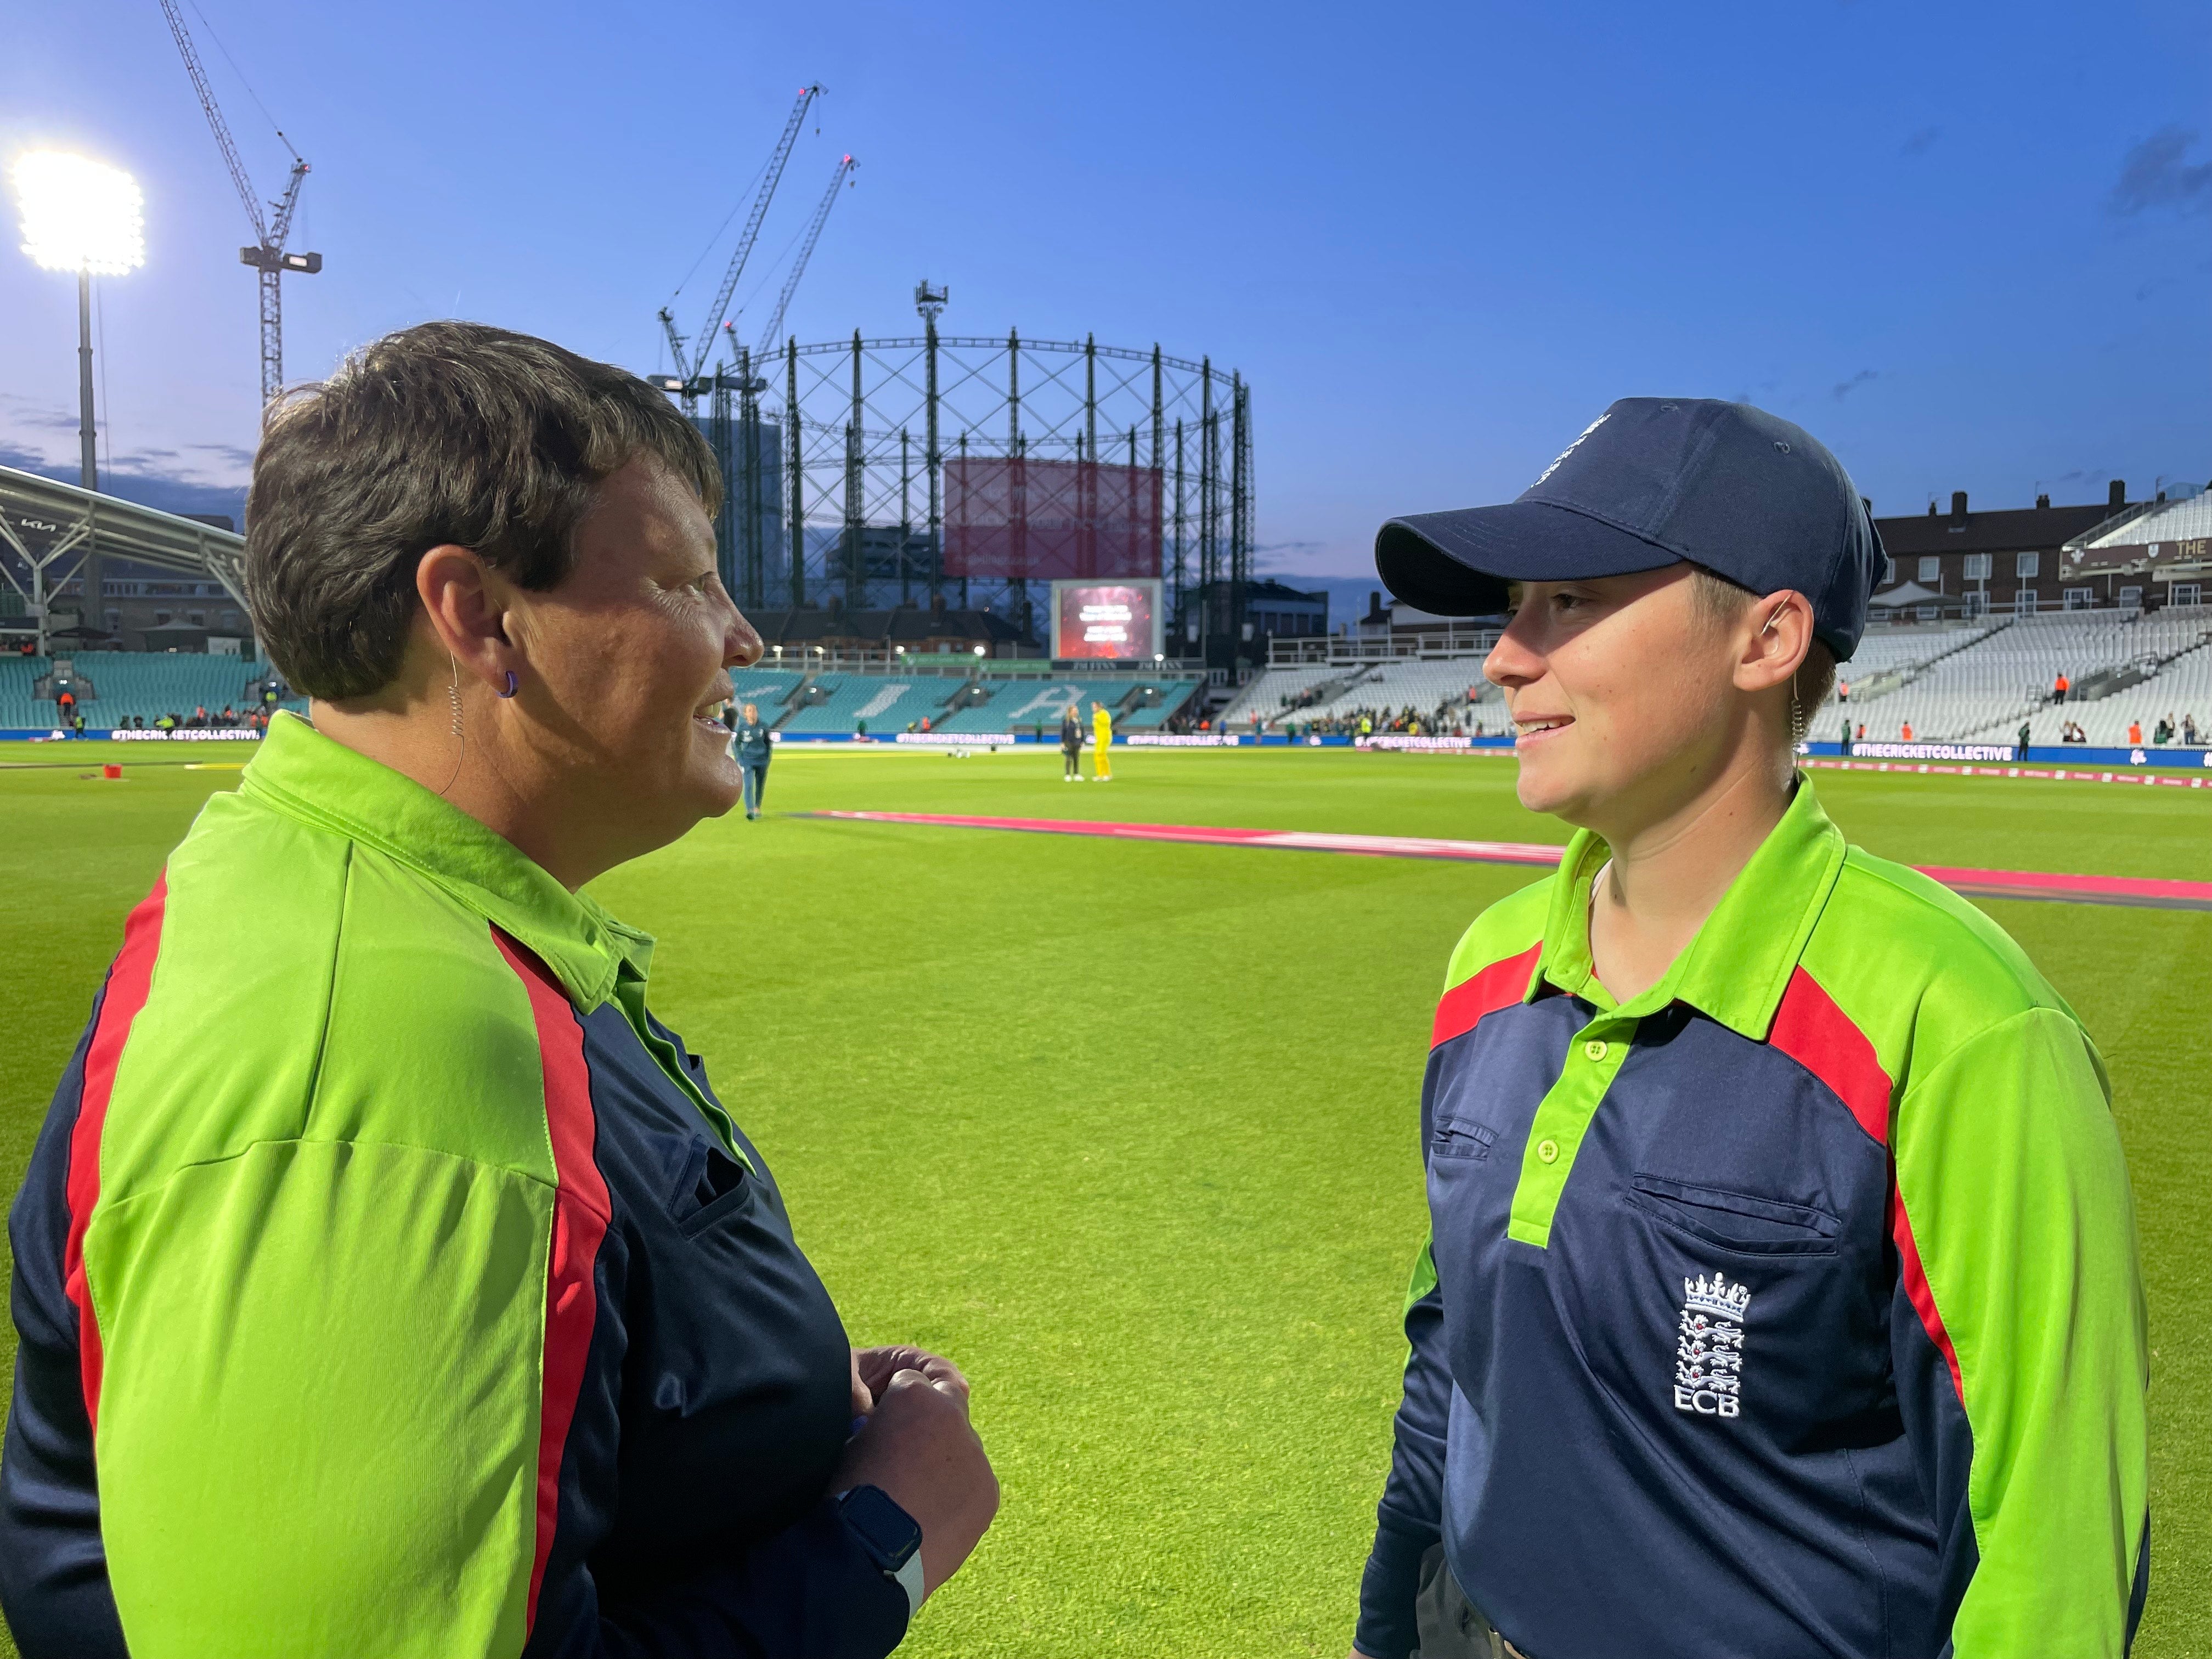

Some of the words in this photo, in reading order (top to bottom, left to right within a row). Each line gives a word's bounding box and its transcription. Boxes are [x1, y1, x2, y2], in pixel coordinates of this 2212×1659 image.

[2176, 539, 2207, 556] THE
[1852, 743, 2012, 761] #THECRICKETCOLLECTIVE
[1674, 1384, 1740, 1418] ECB
